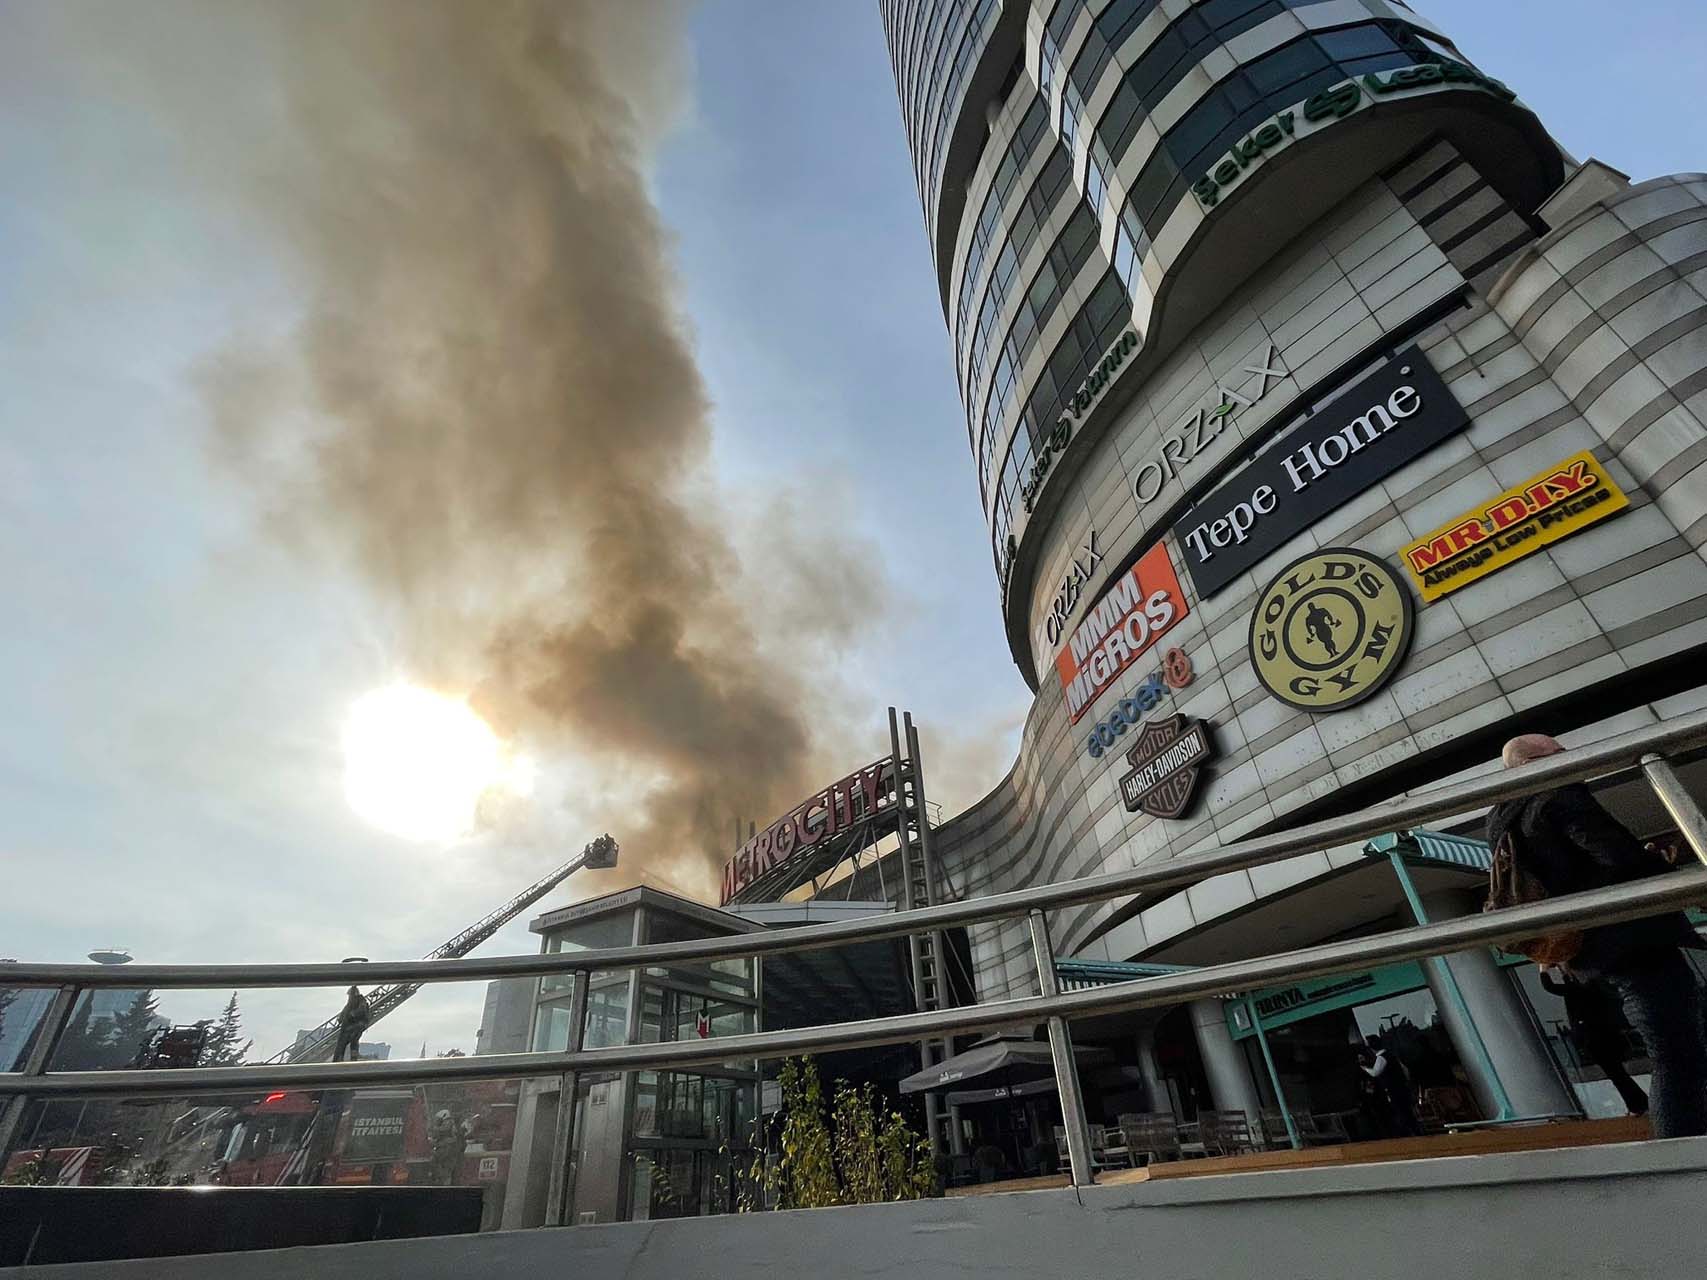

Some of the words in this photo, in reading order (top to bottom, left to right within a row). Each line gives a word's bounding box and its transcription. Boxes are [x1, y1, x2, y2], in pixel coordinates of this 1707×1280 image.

[1134, 345, 1289, 505] ORZAX
[1184, 484, 1277, 563] Tepe
[1280, 385, 1421, 492] Home
[1424, 547, 1494, 588] Always
[1493, 523, 1537, 553] Low
[1540, 487, 1611, 530] Prices
[1047, 530, 1103, 647] ORZAX
[1068, 569, 1143, 666] MMM
[1259, 561, 1385, 661] GOLD'S
[1288, 619, 1396, 697] GYM
[1088, 671, 1171, 758] ebebek
[1136, 726, 1176, 764] MOTOR
[1125, 731, 1201, 800] HARLEY-DAVIDSON
[1149, 771, 1189, 811] CYCLES
[720, 763, 884, 907] METROCITY
